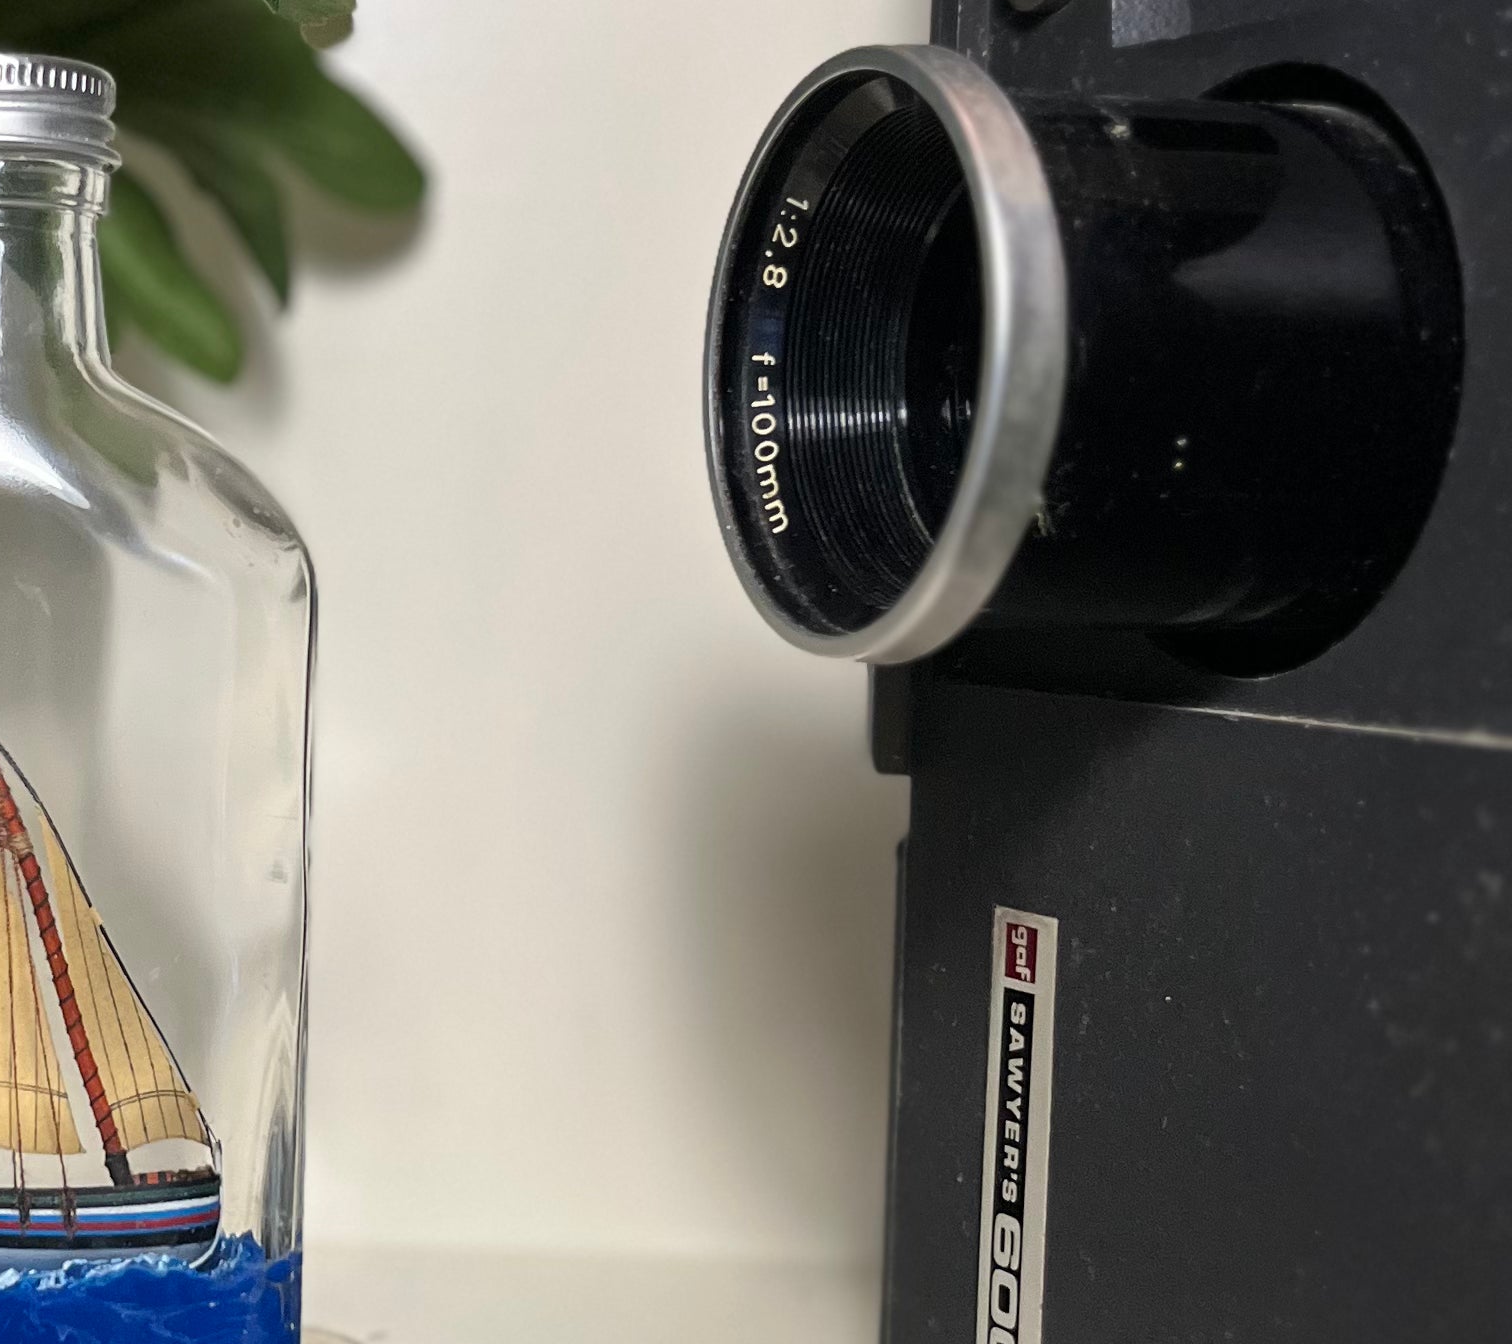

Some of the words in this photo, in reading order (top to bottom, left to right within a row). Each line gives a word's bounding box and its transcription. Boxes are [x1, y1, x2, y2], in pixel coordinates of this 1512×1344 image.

[761, 197, 809, 290] 1:2.8
[1010, 925, 1032, 983] gaf
[1001, 1000, 1026, 1204] SAWYER'S
